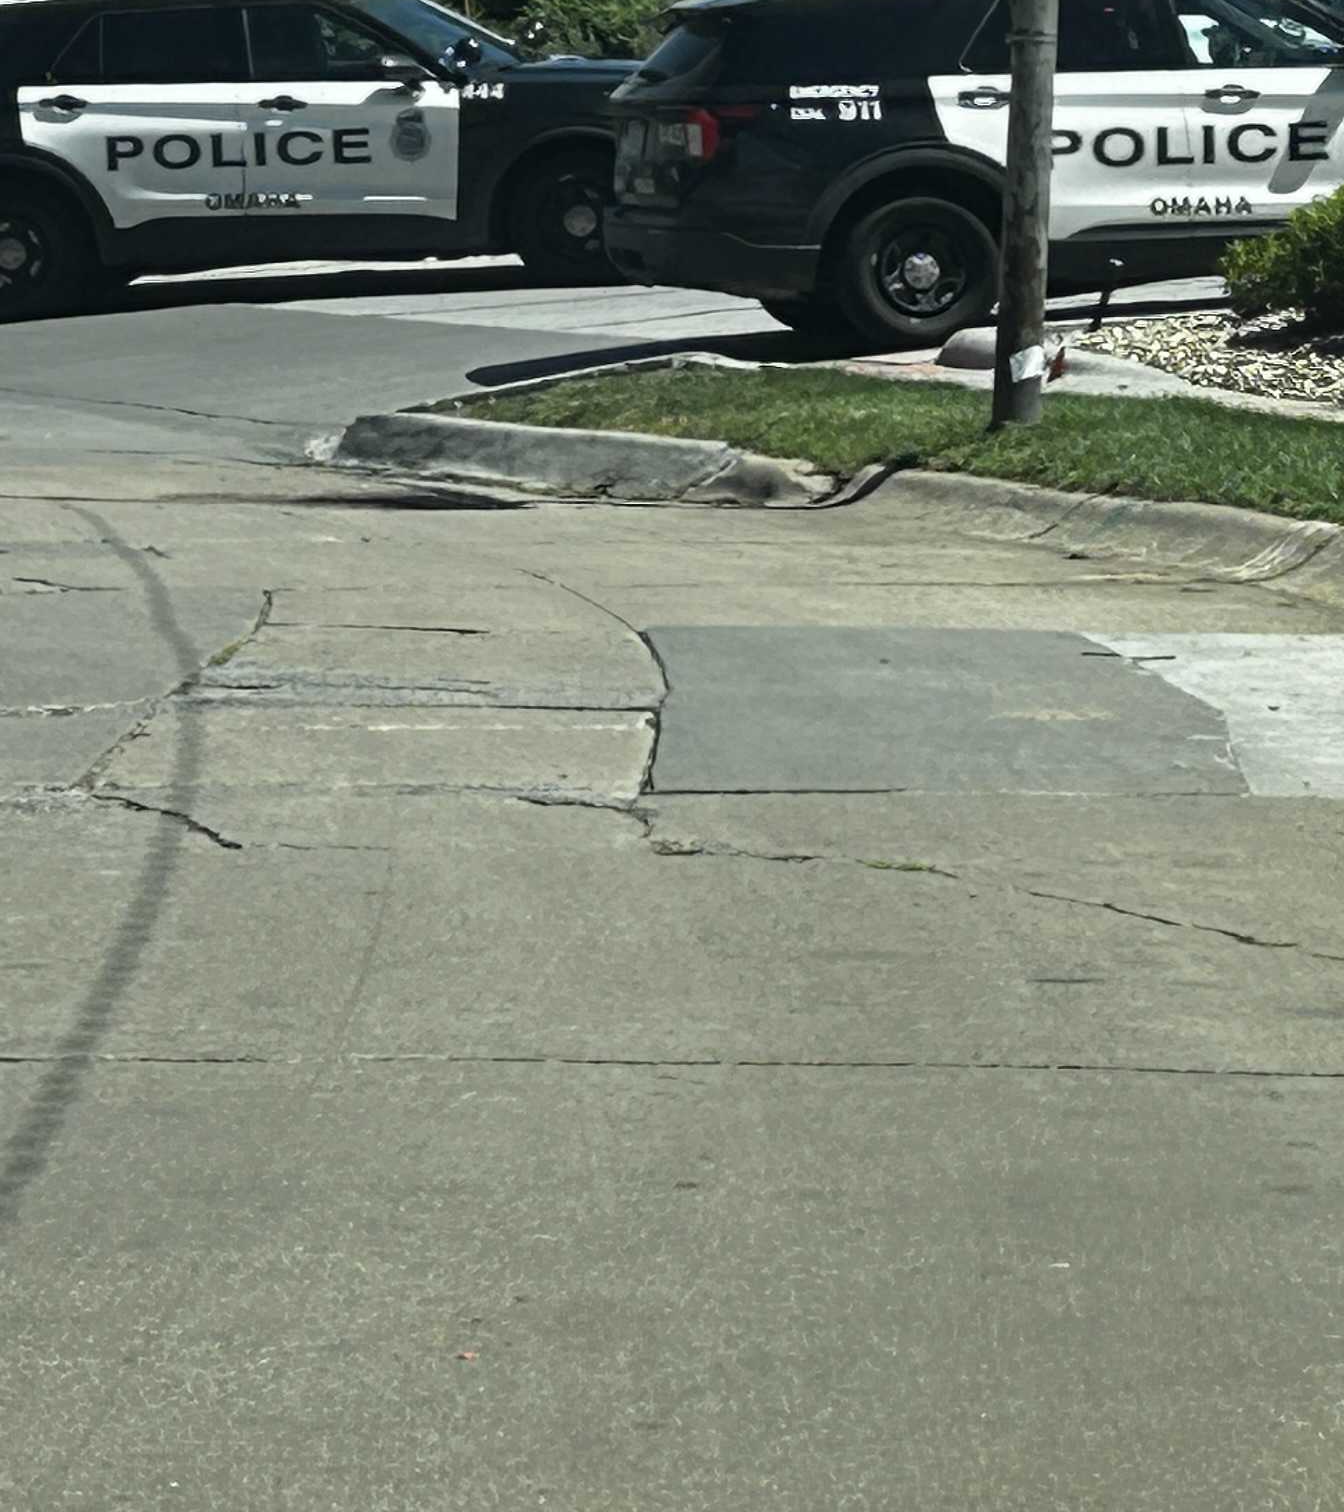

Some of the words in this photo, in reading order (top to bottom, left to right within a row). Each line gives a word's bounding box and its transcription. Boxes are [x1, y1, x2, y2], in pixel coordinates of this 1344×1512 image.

[838, 100, 882, 120] 911
[105, 128, 372, 171] POLICE
[1051, 120, 1329, 167] POLICE
[1149, 195, 1252, 216] OMAHA
